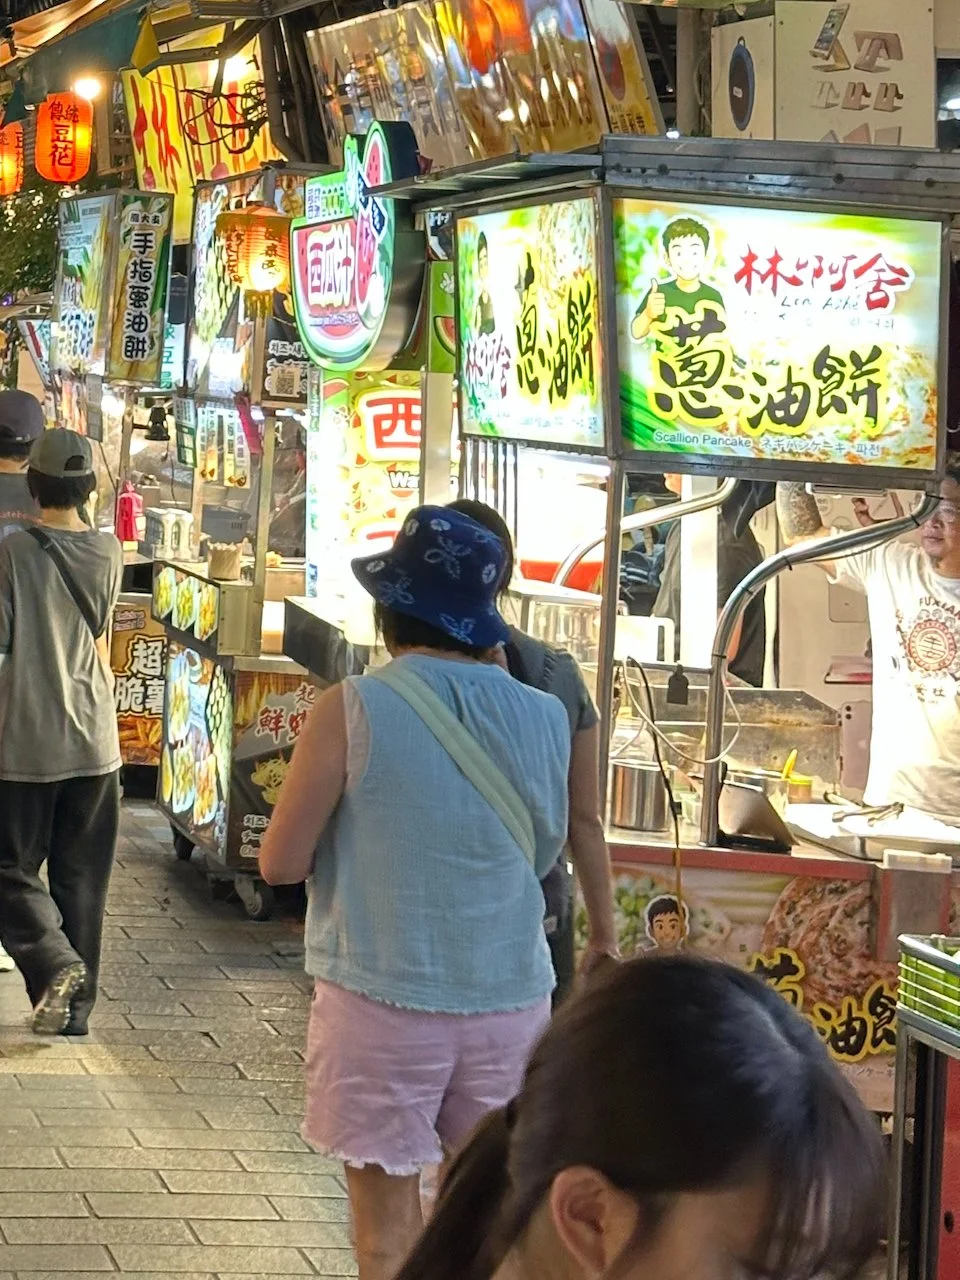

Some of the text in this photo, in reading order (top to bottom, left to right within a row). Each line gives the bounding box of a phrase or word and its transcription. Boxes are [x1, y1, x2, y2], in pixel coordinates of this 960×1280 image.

[48, 124, 74, 167] 豆花
[308, 226, 356, 308] 西瓜汁
[654, 430, 752, 449] Scallion Pancake
